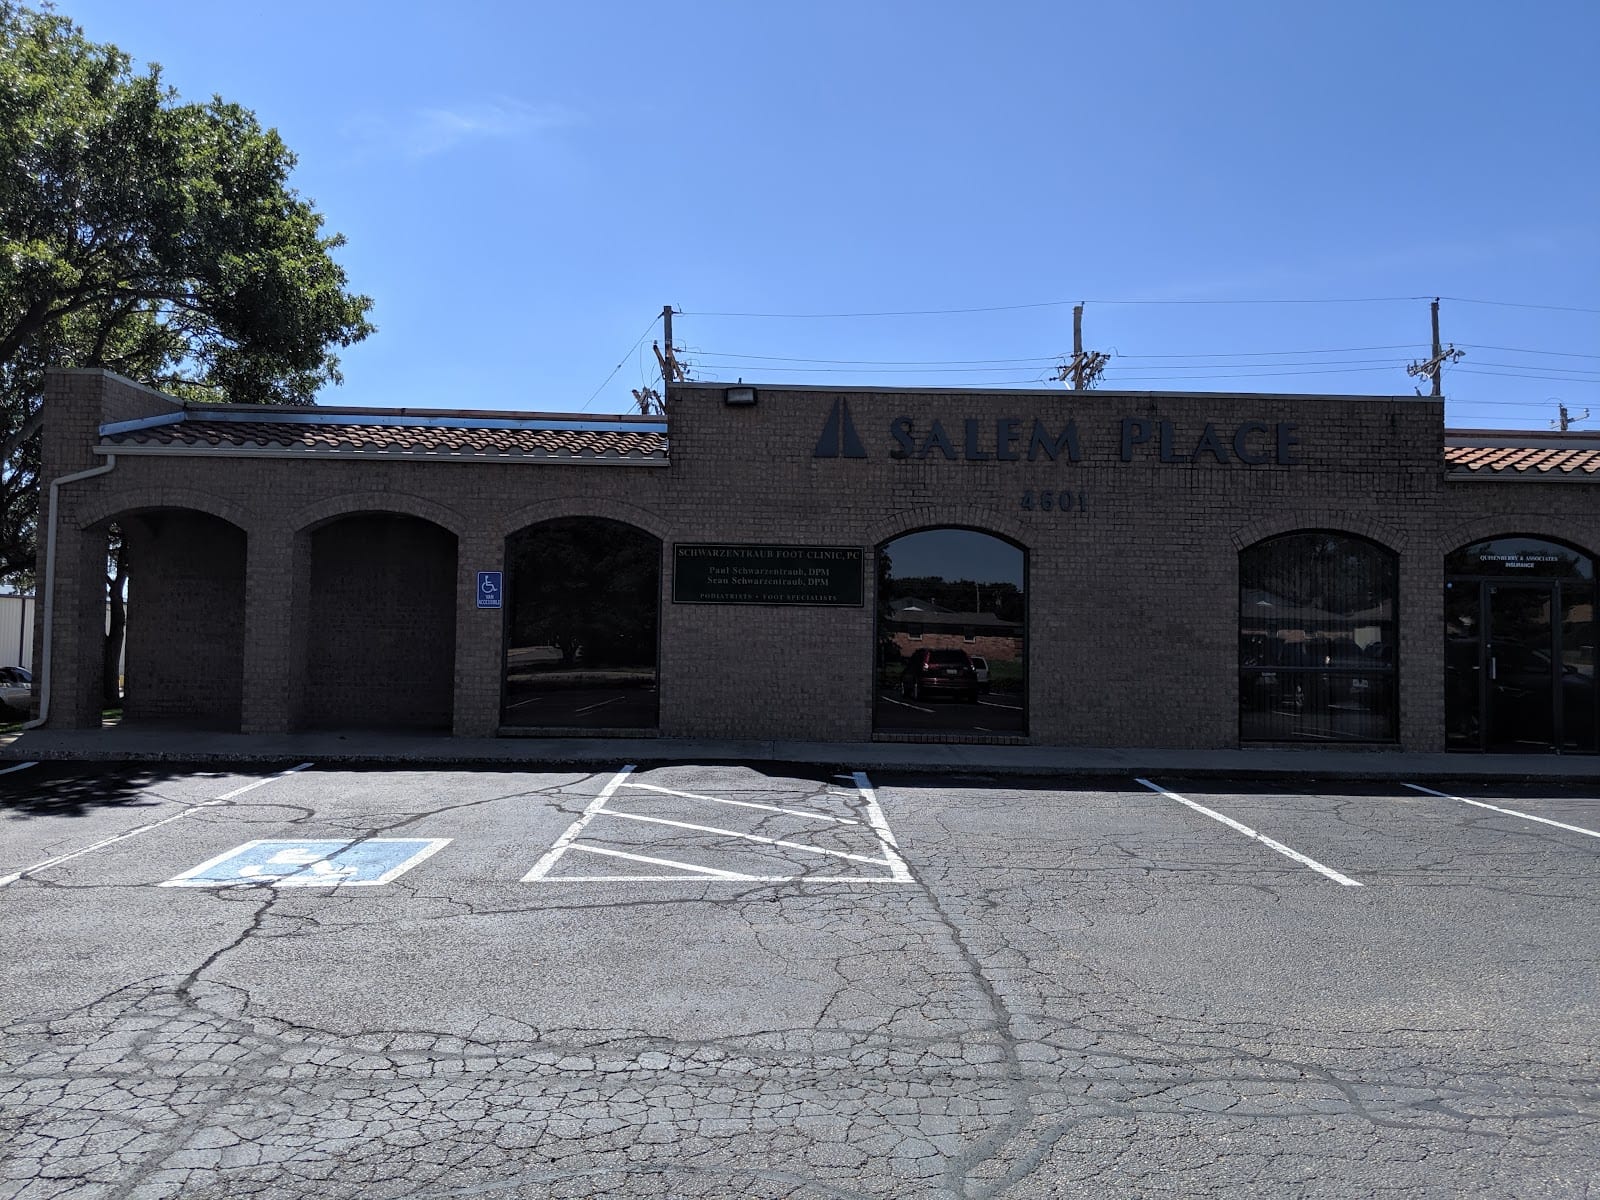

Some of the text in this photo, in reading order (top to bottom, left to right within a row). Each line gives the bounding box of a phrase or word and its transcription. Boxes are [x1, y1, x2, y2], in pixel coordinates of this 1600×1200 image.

[889, 416, 1301, 466] SALEM PLACE
[1022, 490, 1087, 512] 4601
[678, 548, 774, 559] SCHWARZENTRAUB
[776, 550, 804, 559] FOOT
[847, 551, 861, 560] PC
[709, 567, 730, 575] Paul
[809, 568, 830, 576] DPM
[707, 577, 730, 585] Sean
[808, 578, 829, 586] DPM
[700, 592, 839, 602] PODIATRISTS FOOT SPECIALISTS
